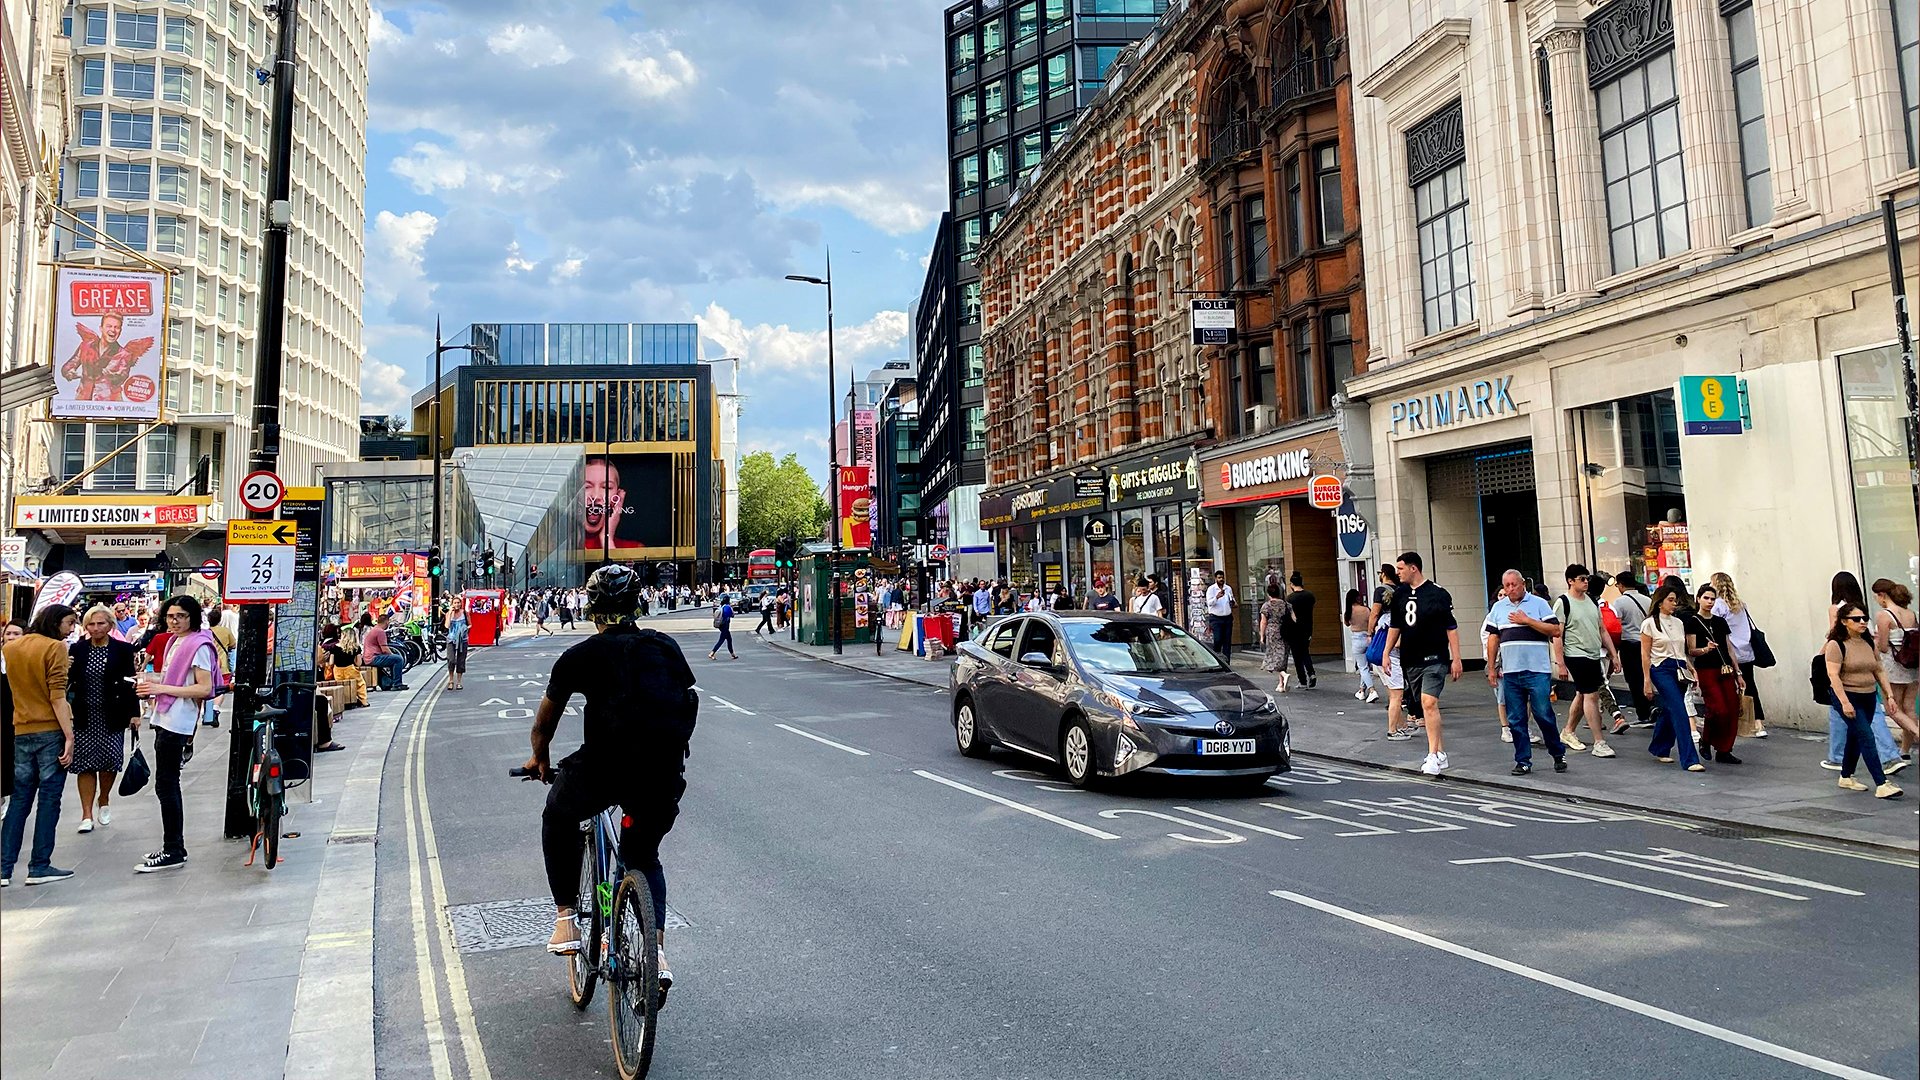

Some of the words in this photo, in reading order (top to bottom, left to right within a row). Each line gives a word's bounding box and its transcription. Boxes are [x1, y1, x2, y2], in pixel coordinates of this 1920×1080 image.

[79, 289, 147, 308] GREASE
[1199, 301, 1211, 309] TO
[1214, 301, 1228, 309] LET
[1391, 374, 1517, 435] PRIMARK
[1121, 470, 1140, 489] GIFTS
[1148, 461, 1181, 484] GIGGLES
[1232, 456, 1277, 488] BURGER
[1278, 448, 1310, 480] KING
[247, 483, 278, 500] 20
[842, 484, 867, 492] Hungry?
[1142, 489, 1156, 500] LONDON
[1164, 486, 1174, 496] SHOP
[1314, 493, 1341, 501] KING
[38, 508, 89, 522] LIMITED
[91, 508, 140, 522] SEASON
[158, 508, 195, 521] GREASE
[251, 554, 273, 568] 24
[251, 569, 272, 584] 29
[1405, 600, 1417, 626] 8
[1206, 742, 1229, 753] DG18
[1232, 741, 1252, 752] YYD
